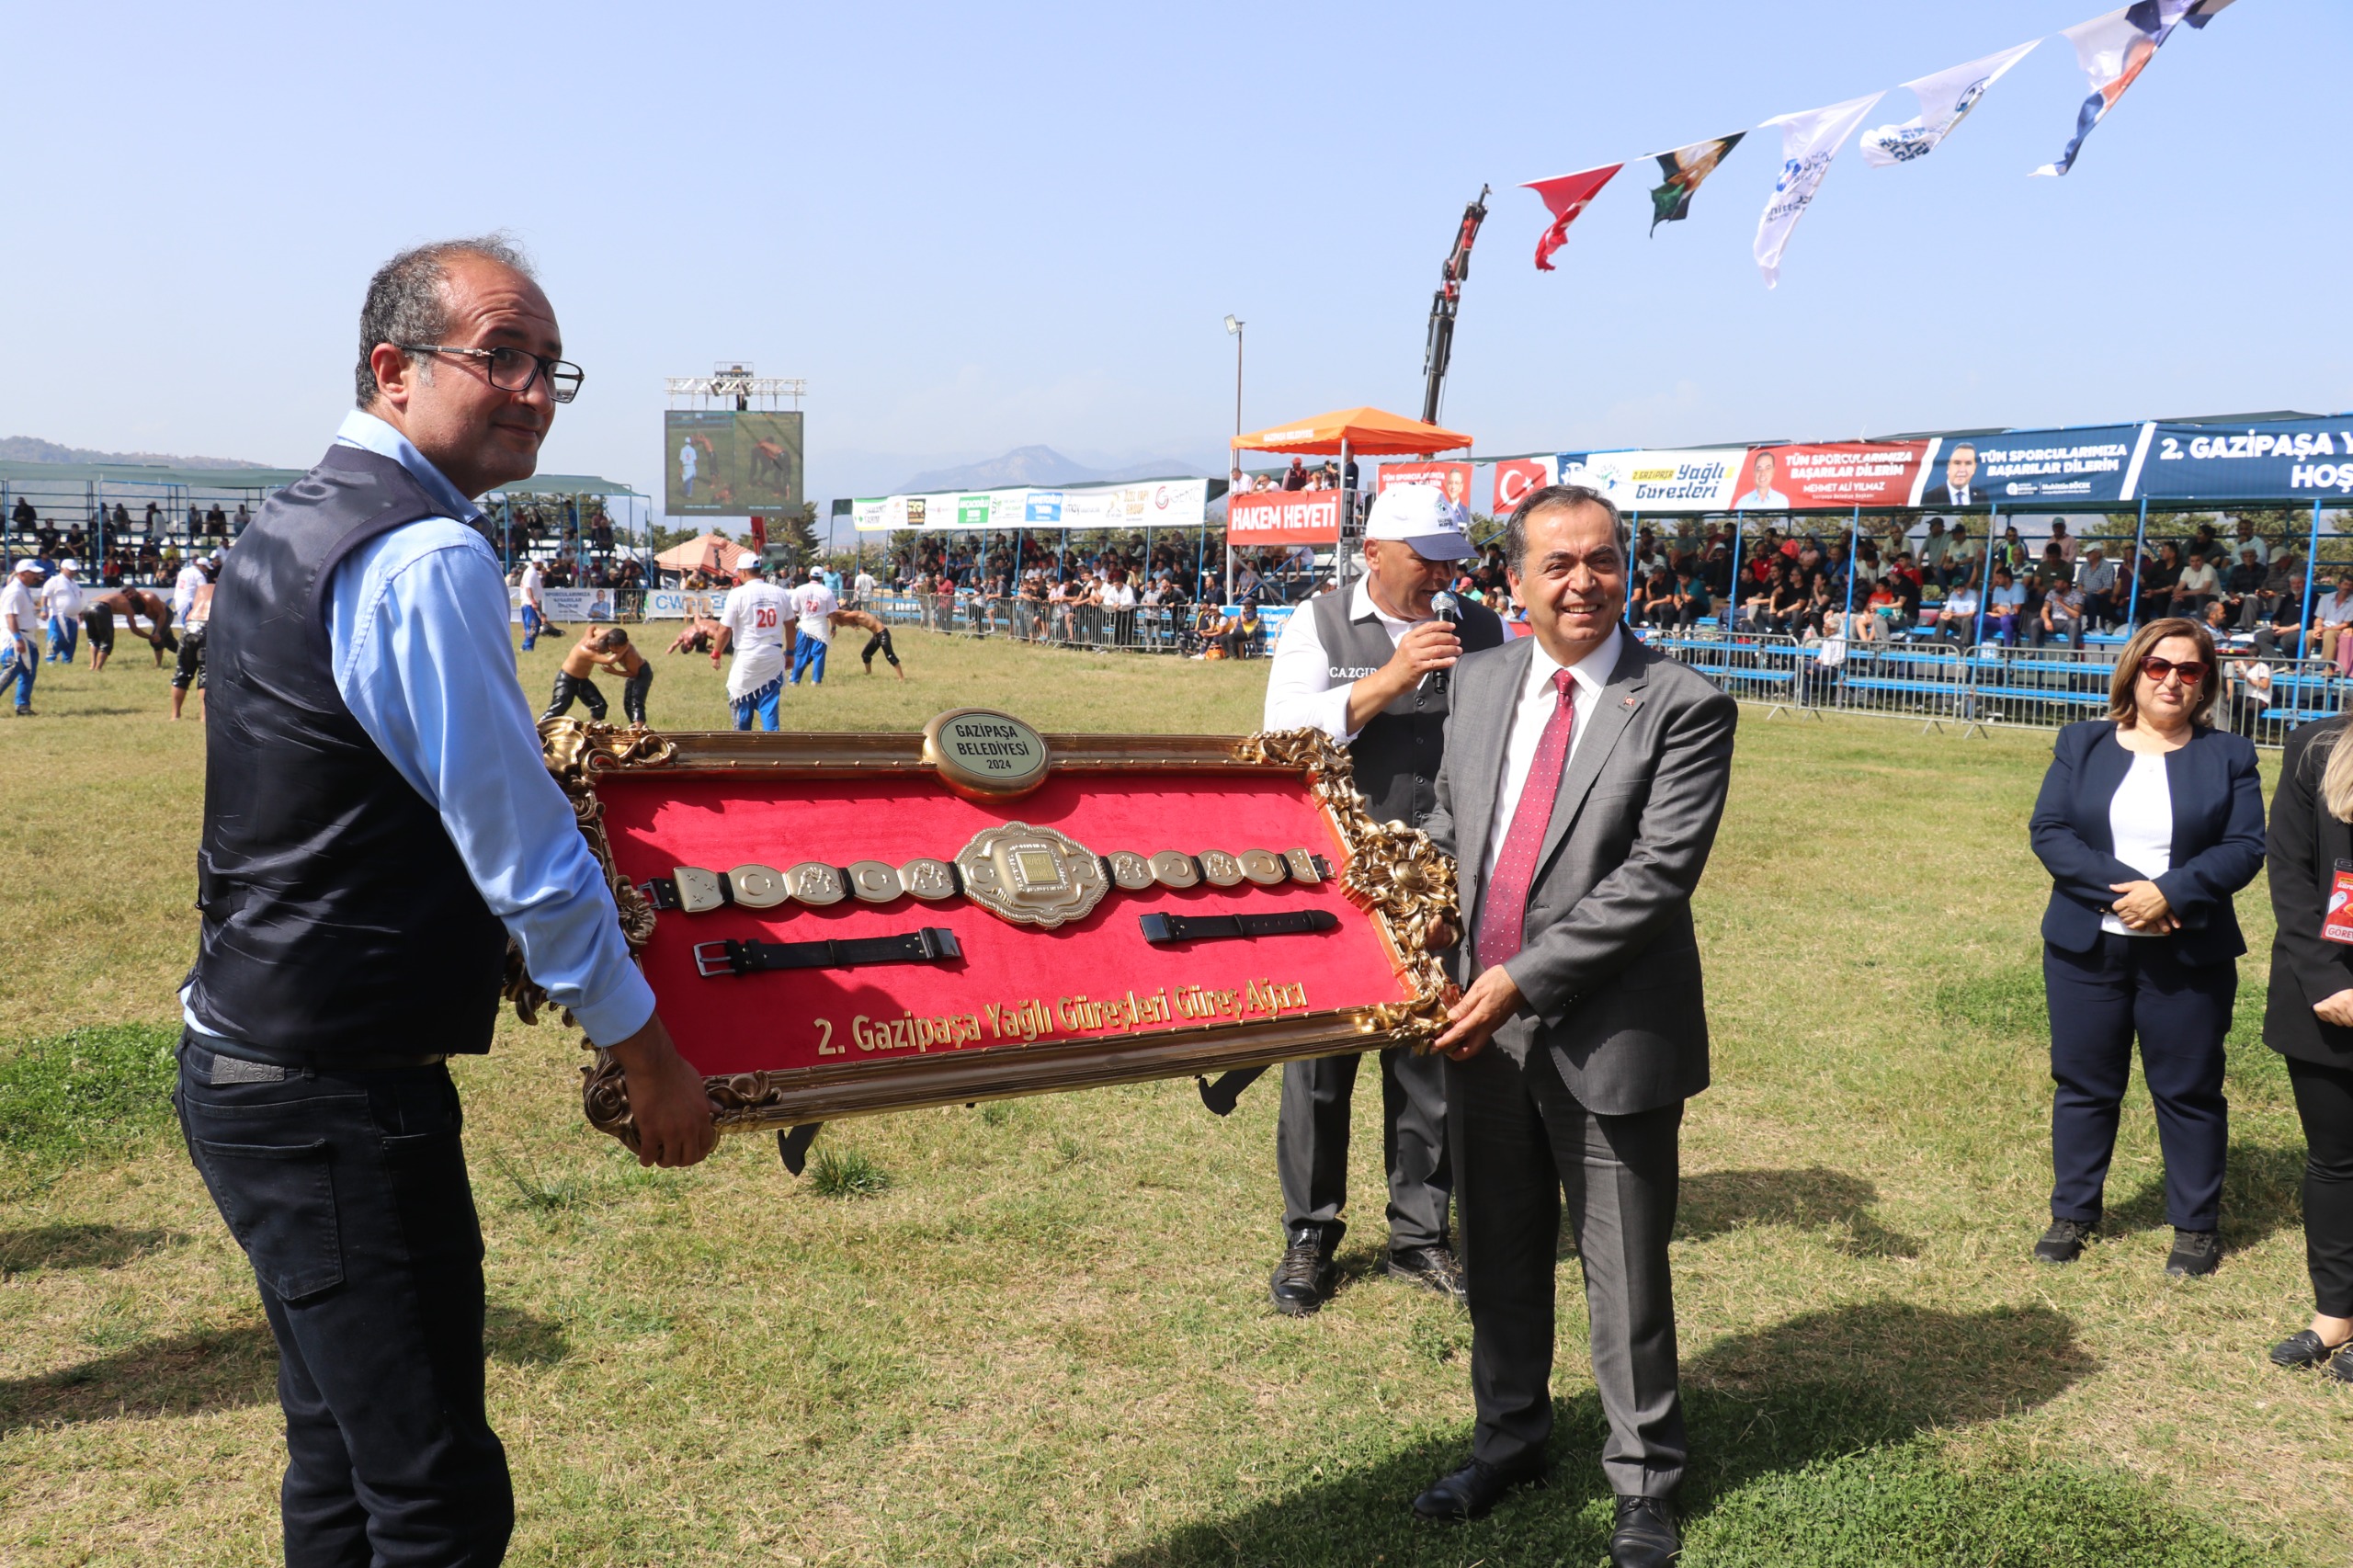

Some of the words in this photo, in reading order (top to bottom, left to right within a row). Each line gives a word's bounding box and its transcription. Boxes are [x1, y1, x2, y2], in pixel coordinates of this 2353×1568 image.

[1979, 449, 2007, 464] TÜM
[2009, 444, 2127, 462] SPORCULARIMIZA
[2160, 437, 2184, 460] 2.
[2189, 428, 2335, 461] GAZİPAŞA
[1786, 453, 1810, 466] TÜM
[1812, 451, 1913, 465] SPORCULARIMIZA
[1987, 461, 2062, 477] BAŞARILAR
[2063, 457, 2119, 473] DİLERİM
[1677, 462, 1725, 484] Yağlı
[1790, 467, 1854, 481] BAŞARILAR
[1856, 463, 1904, 476] DİLERİM
[1636, 482, 1720, 501] Güreşleri
[1803, 483, 1837, 493] MEHMET
[1838, 482, 1852, 492] ALİ
[1854, 482, 1885, 492] YILMAZ
[1232, 506, 1280, 530] HAKEM
[1283, 496, 1336, 529] HEYETİ
[756, 608, 777, 628] 20
[956, 722, 1018, 741] GAZİPAŞA
[957, 741, 1030, 756] BELEDİYESİ
[986, 759, 1012, 769] 2024
[2328, 926, 2353, 939] GÖRE
[814, 1017, 846, 1055] 2.
[852, 1010, 982, 1053] Gazipaşa
[983, 998, 1054, 1041] Yağlı
[1058, 987, 1172, 1031] Güreşleri
[1173, 984, 1243, 1018] Güreş
[1245, 977, 1308, 1016] Ağası
